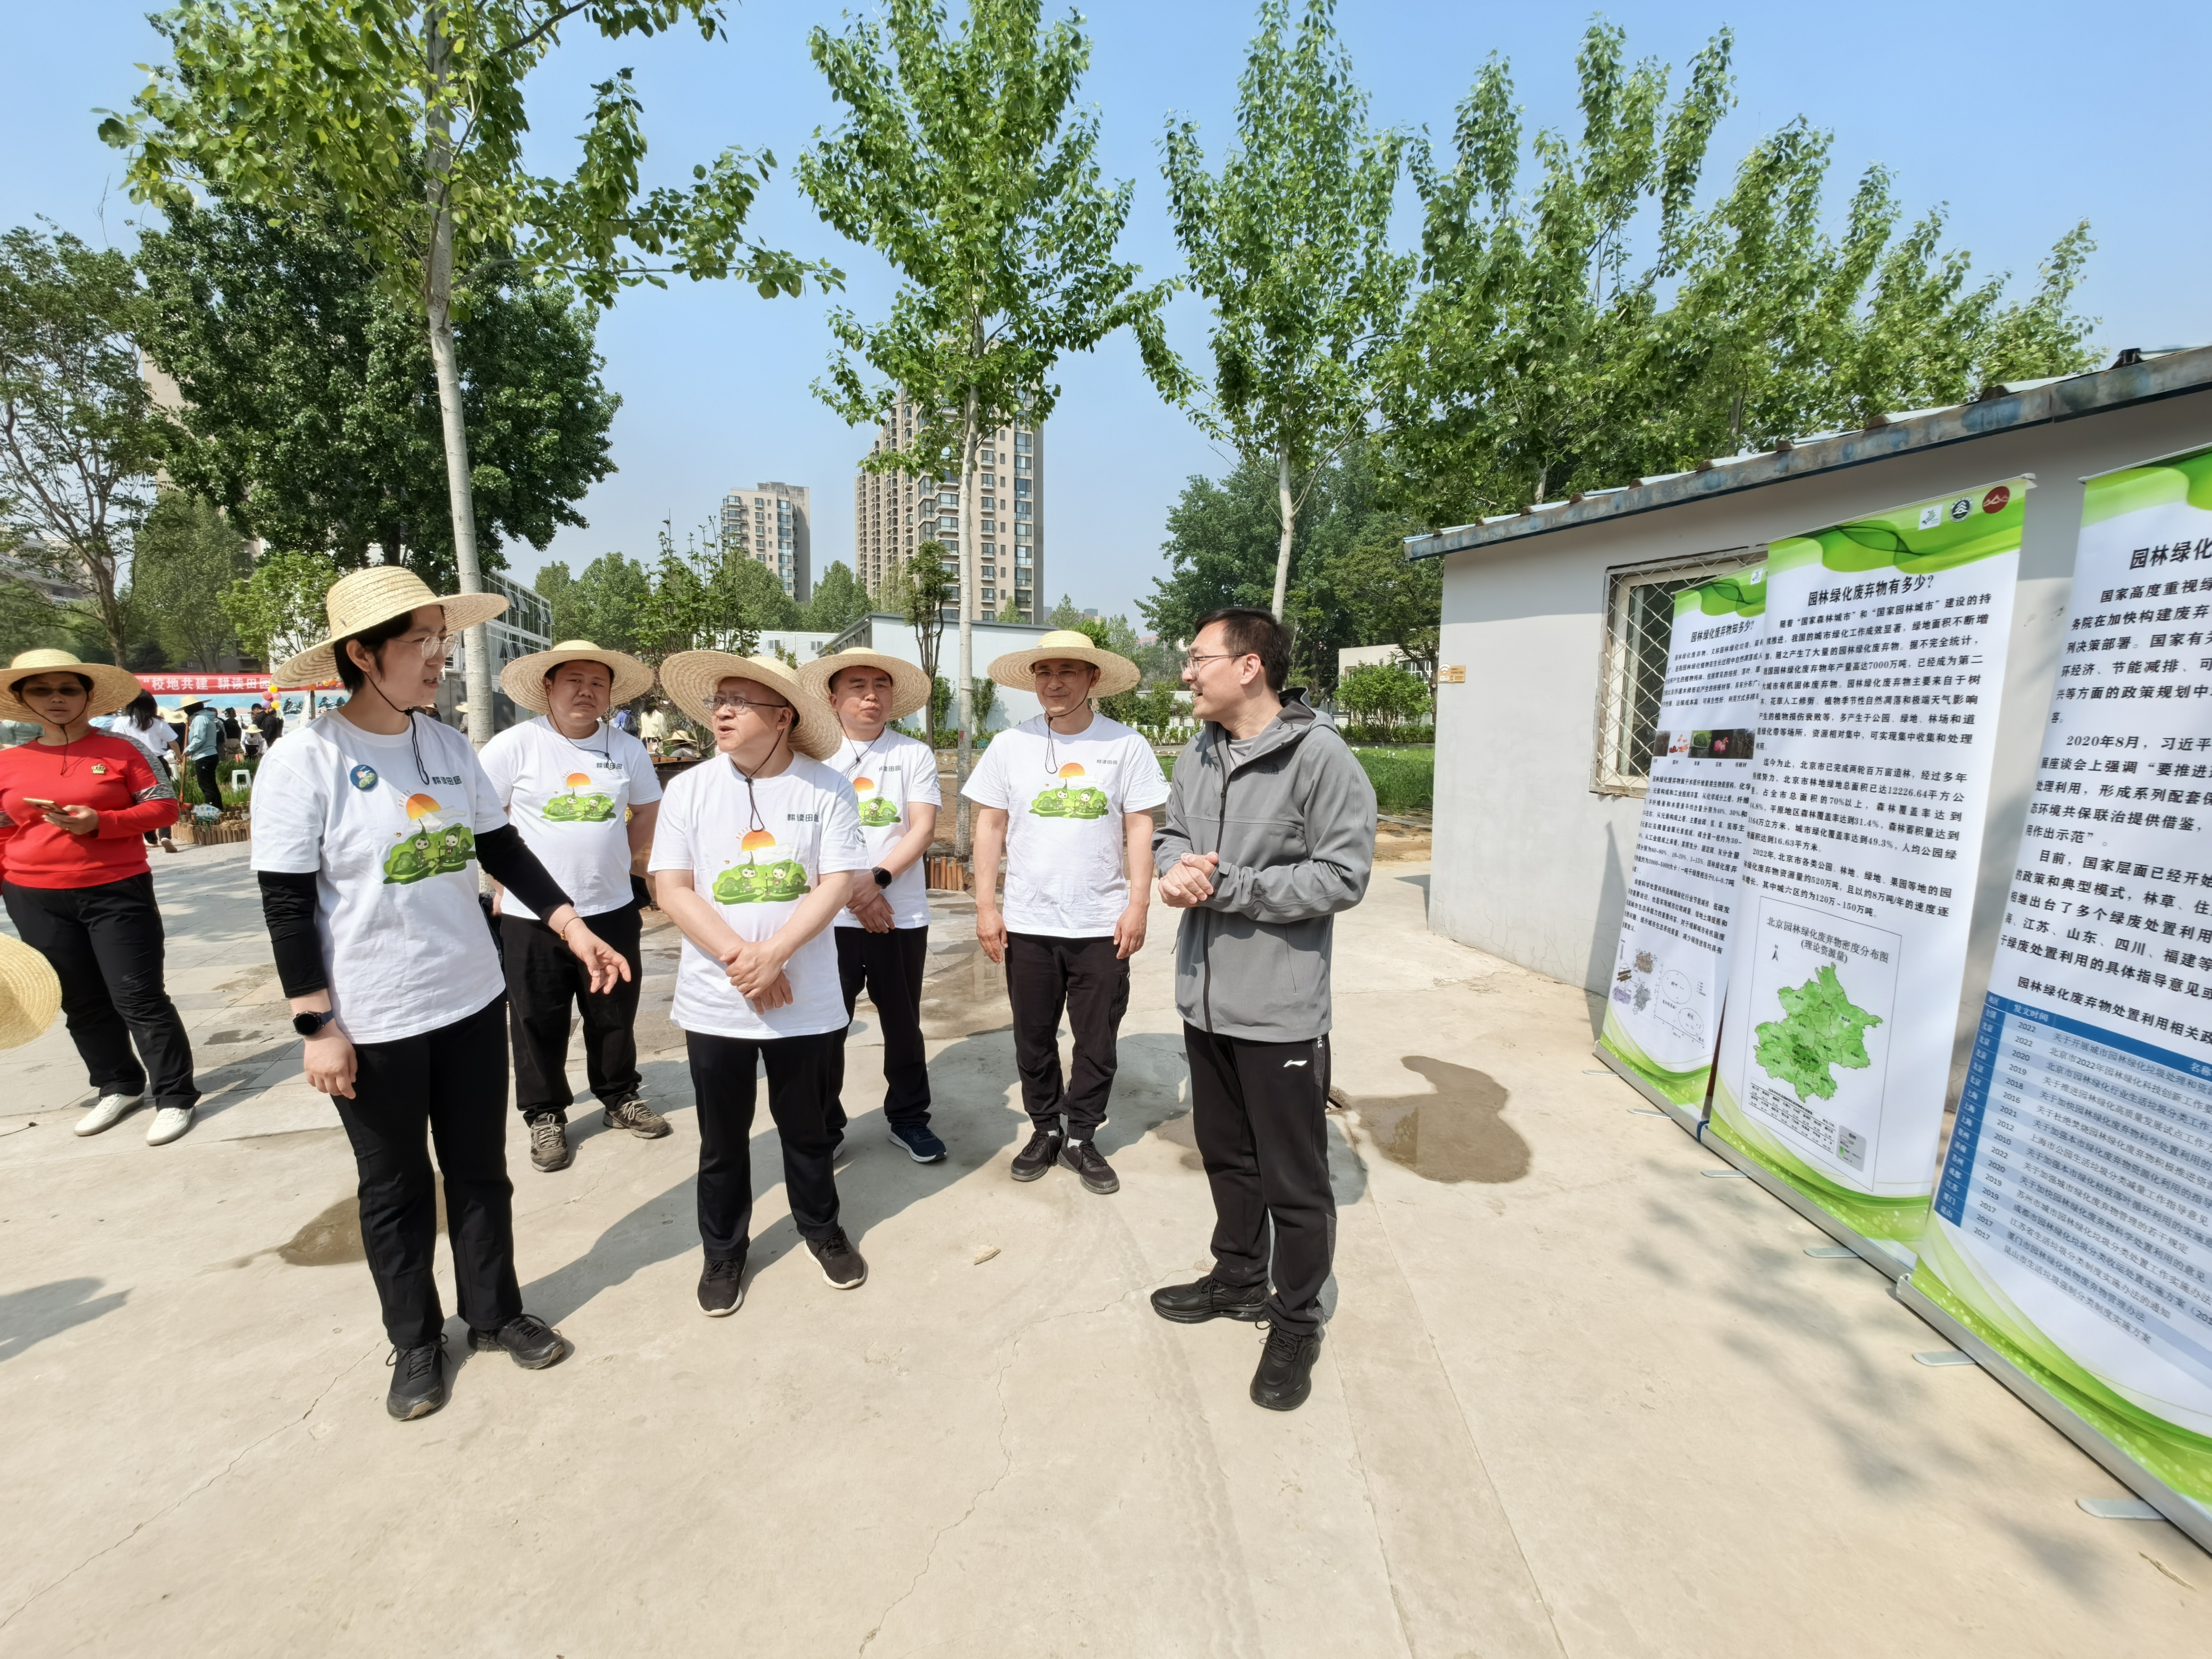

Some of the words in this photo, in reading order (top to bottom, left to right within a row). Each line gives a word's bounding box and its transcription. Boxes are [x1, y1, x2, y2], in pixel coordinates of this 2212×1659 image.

[2071, 605, 2212, 631] 务院在加快构建废弃
[2056, 684, 2212, 700] 兴等方面的政策规划中
[2015, 868, 2212, 916] 的政策和典型模式，林草、住
[2018, 1022, 2035, 1033] 2022
[2015, 1036, 2033, 1048] 2022
[2012, 1050, 2030, 1061] 2020
[2009, 1065, 2027, 1076] 2019
[2006, 1078, 2023, 1090] 2018
[2003, 1092, 2021, 1103] 2016
[2000, 1106, 2017, 1117] 2021
[1997, 1119, 2014, 1132] 2012
[1994, 1133, 2011, 1145] 2010
[1991, 1147, 2008, 1159] 2022
[1988, 1160, 2005, 1172] 2020
[1985, 1174, 2002, 1186] 2019
[1982, 1187, 1999, 1200] 2019
[1980, 1201, 1996, 1213] 2017
[1976, 1214, 1993, 1226] 2017
[1974, 1227, 1990, 1240] 2017
